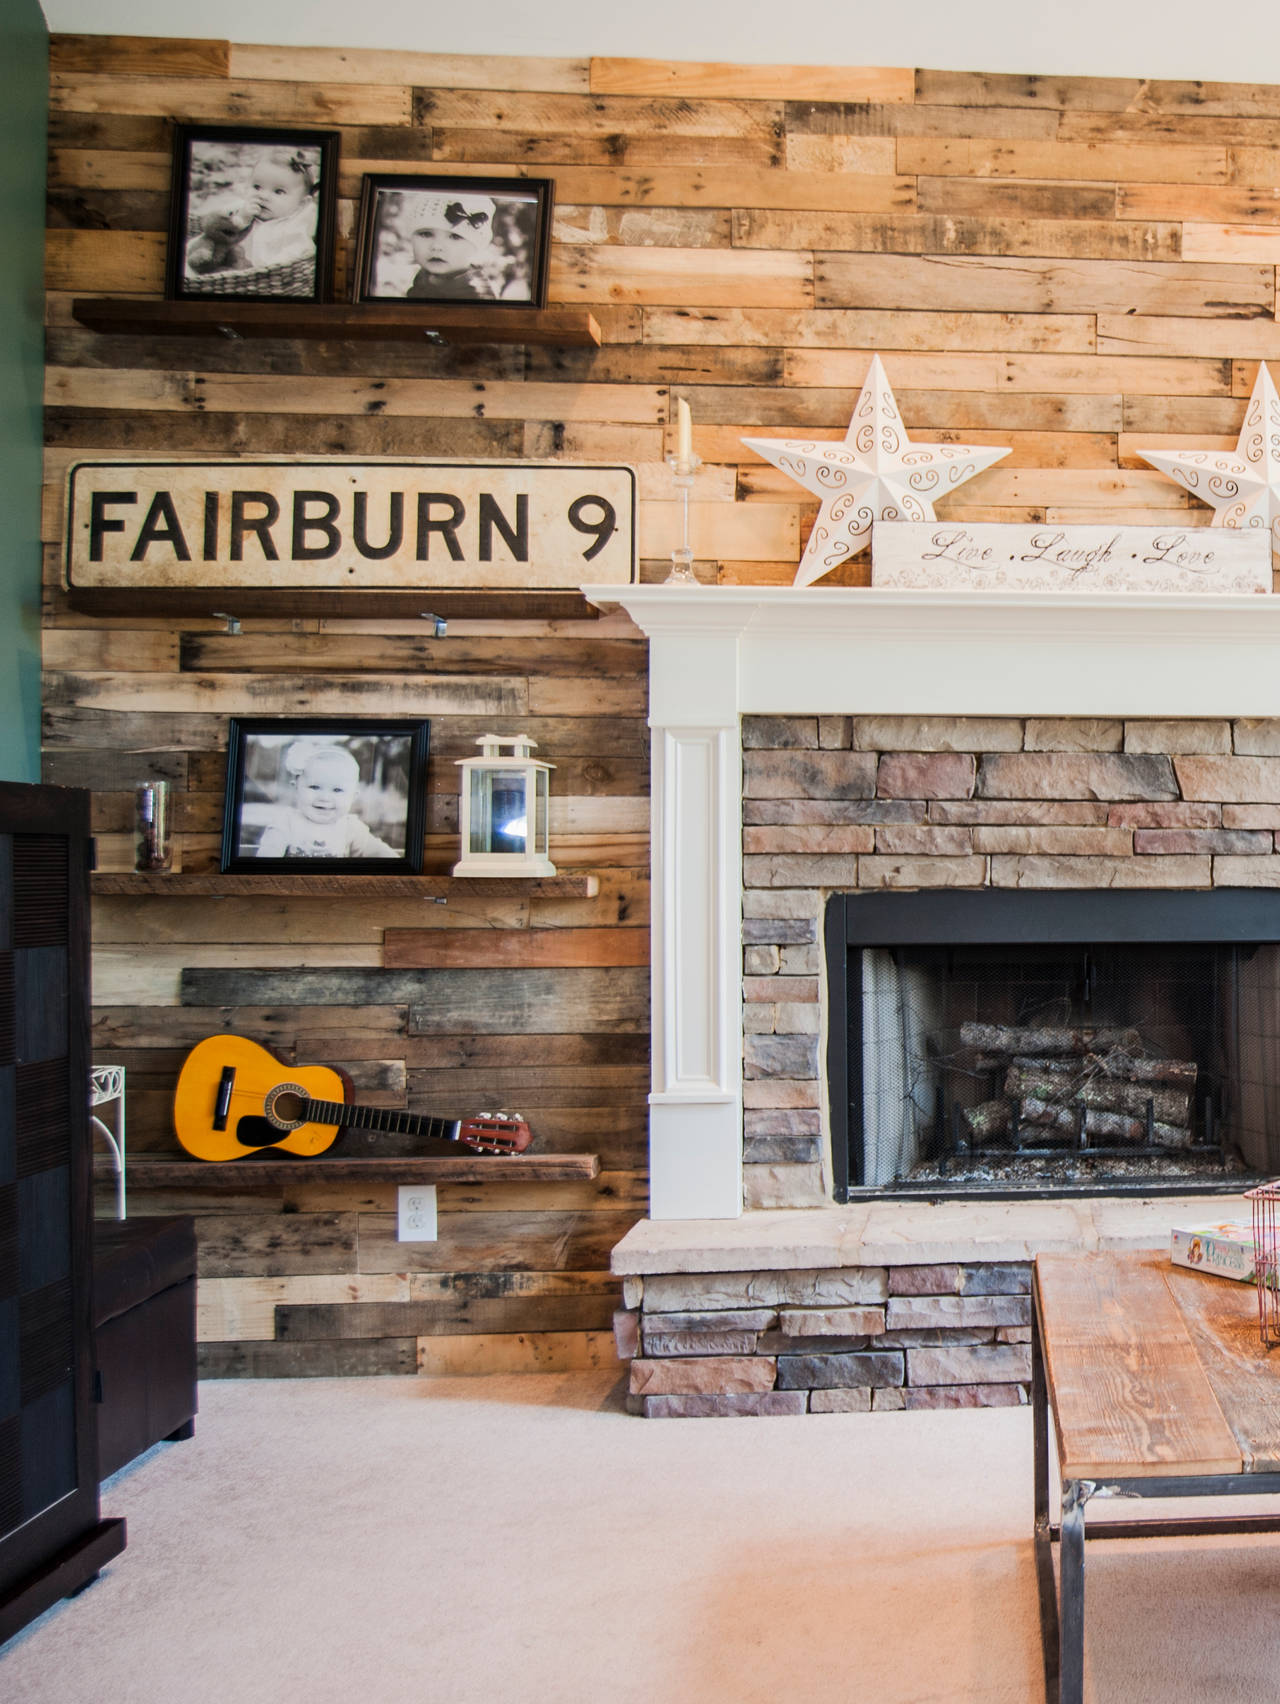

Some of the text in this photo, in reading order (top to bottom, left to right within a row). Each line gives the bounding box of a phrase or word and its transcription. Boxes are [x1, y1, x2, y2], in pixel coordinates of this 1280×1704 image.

[89, 491, 617, 562] FAIRBURN 9
[921, 530, 1220, 578] Live Laugh Love
